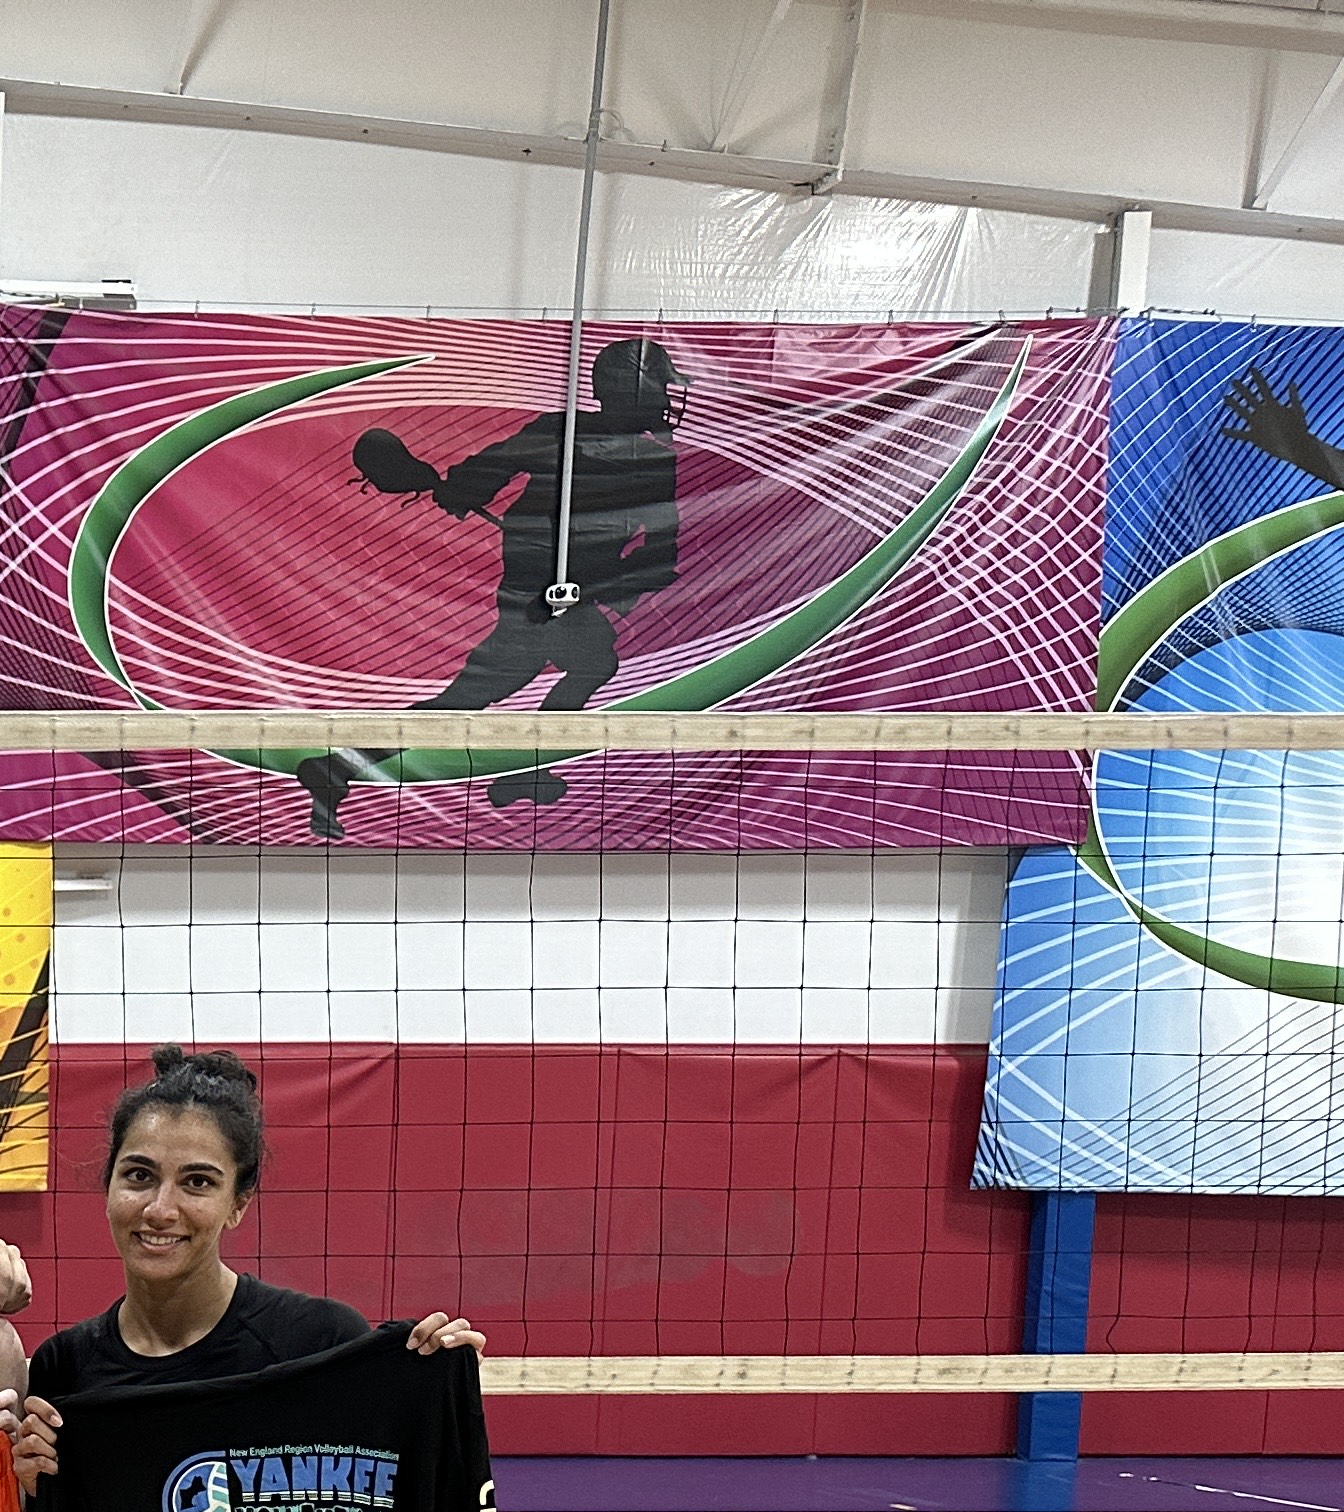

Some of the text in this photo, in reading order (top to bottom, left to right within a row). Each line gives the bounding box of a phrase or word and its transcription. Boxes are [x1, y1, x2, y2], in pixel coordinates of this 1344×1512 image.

[230, 1444, 399, 1461] New England Region Volleyball Association
[230, 1456, 398, 1508] YANKEE
